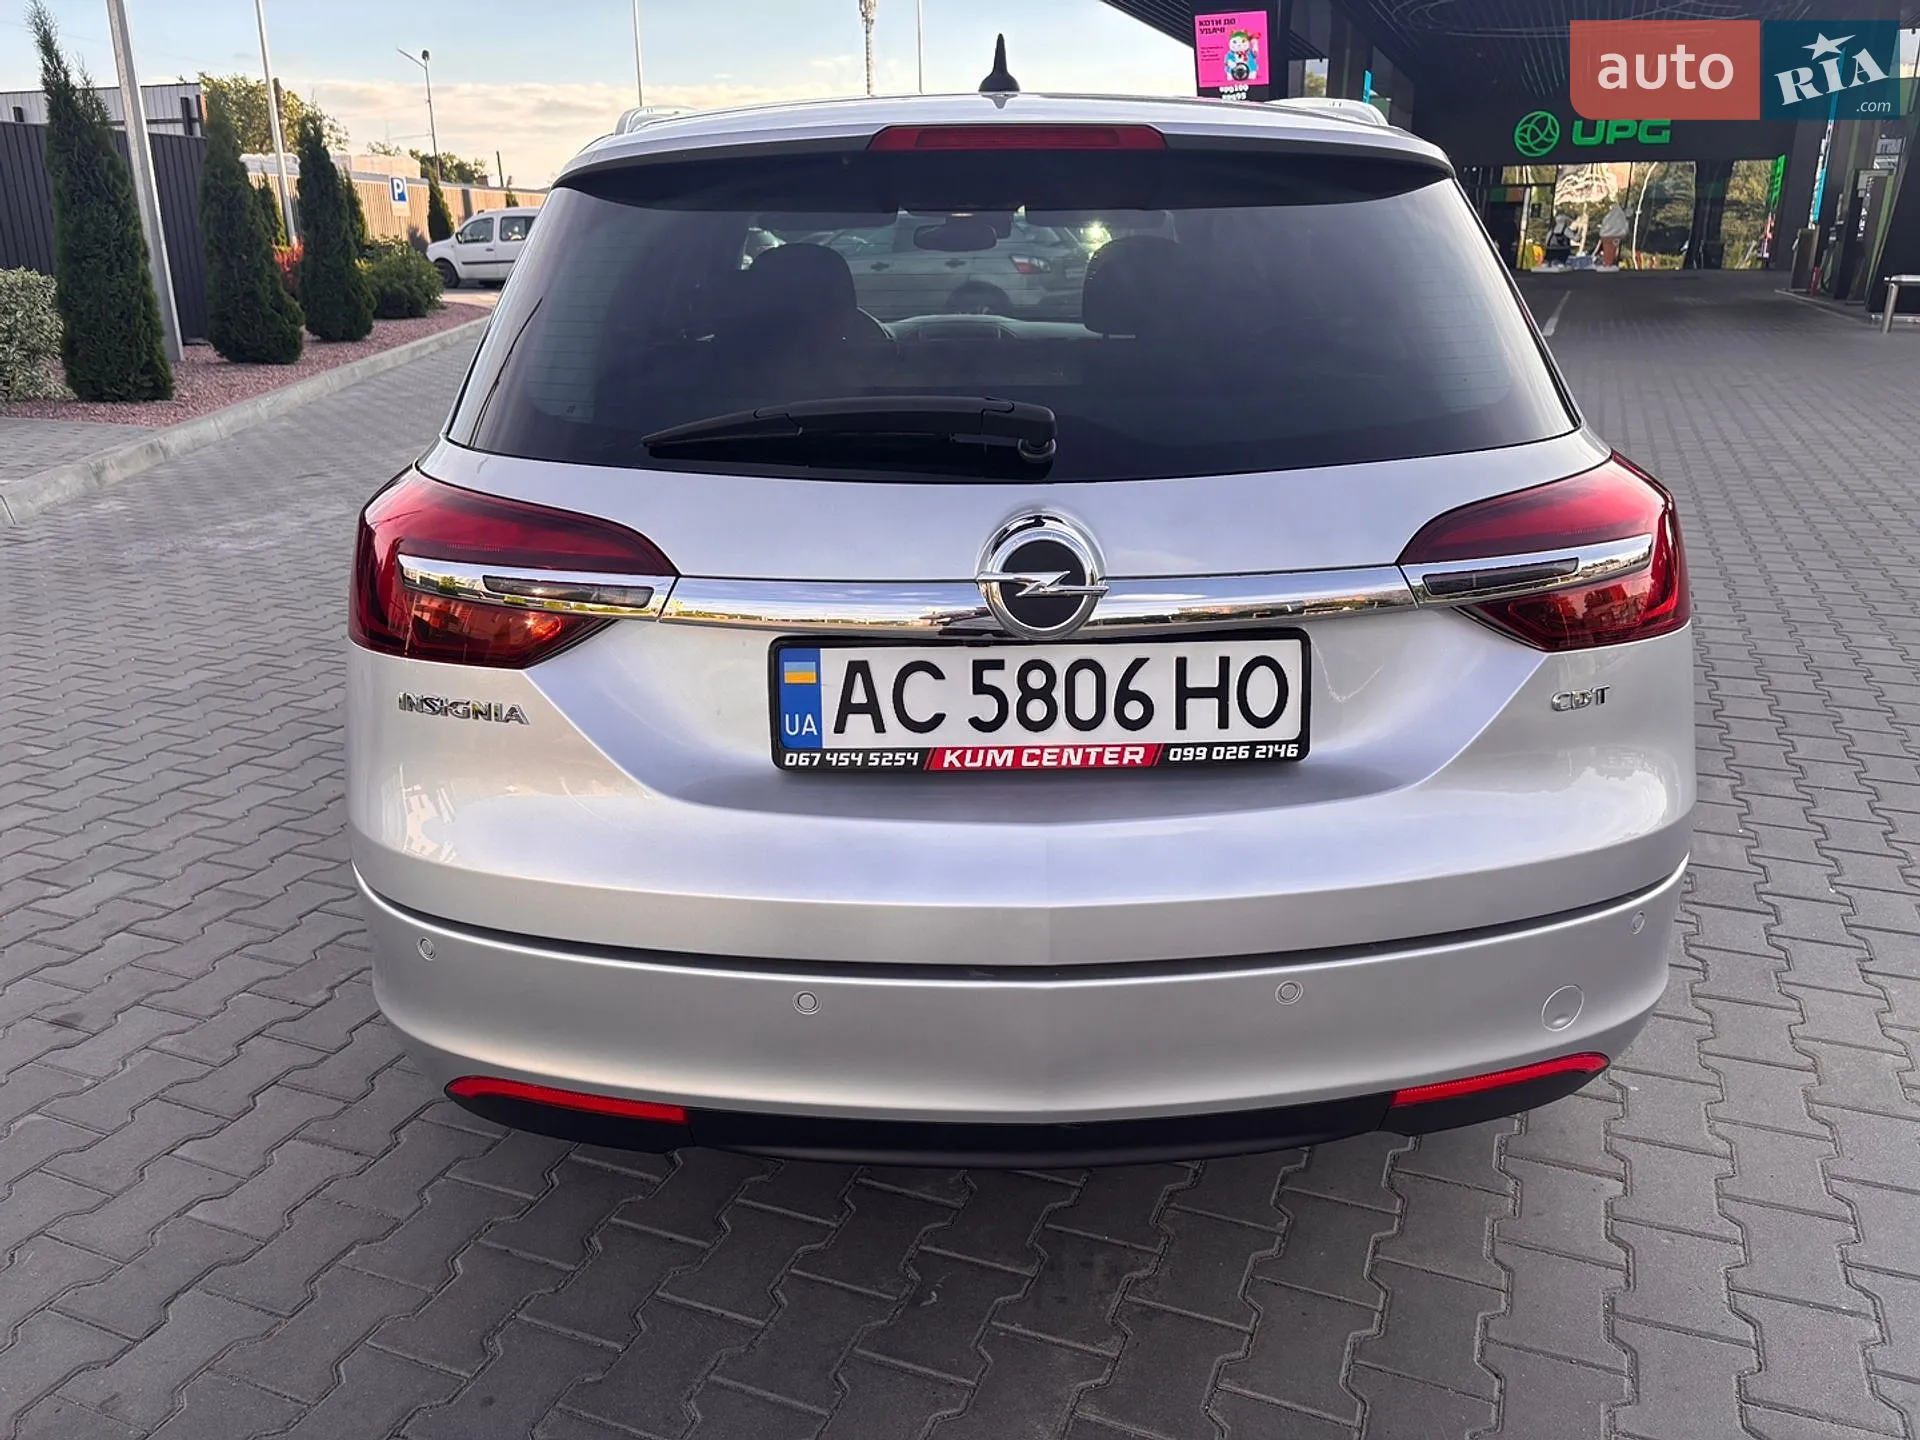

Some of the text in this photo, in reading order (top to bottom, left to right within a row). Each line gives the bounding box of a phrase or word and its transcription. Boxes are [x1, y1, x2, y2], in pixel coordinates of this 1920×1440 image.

[1572, 118, 1671, 146] UPG
[393, 179, 404, 200] P
[833, 655, 1289, 734] AC 5806 HO
[398, 692, 529, 725] INSIGNIA
[784, 713, 818, 736] UA
[784, 751, 919, 766] 067 454 5254
[943, 747, 1144, 768] KUM CENTER
[1169, 744, 1299, 761] 099 026 2146
